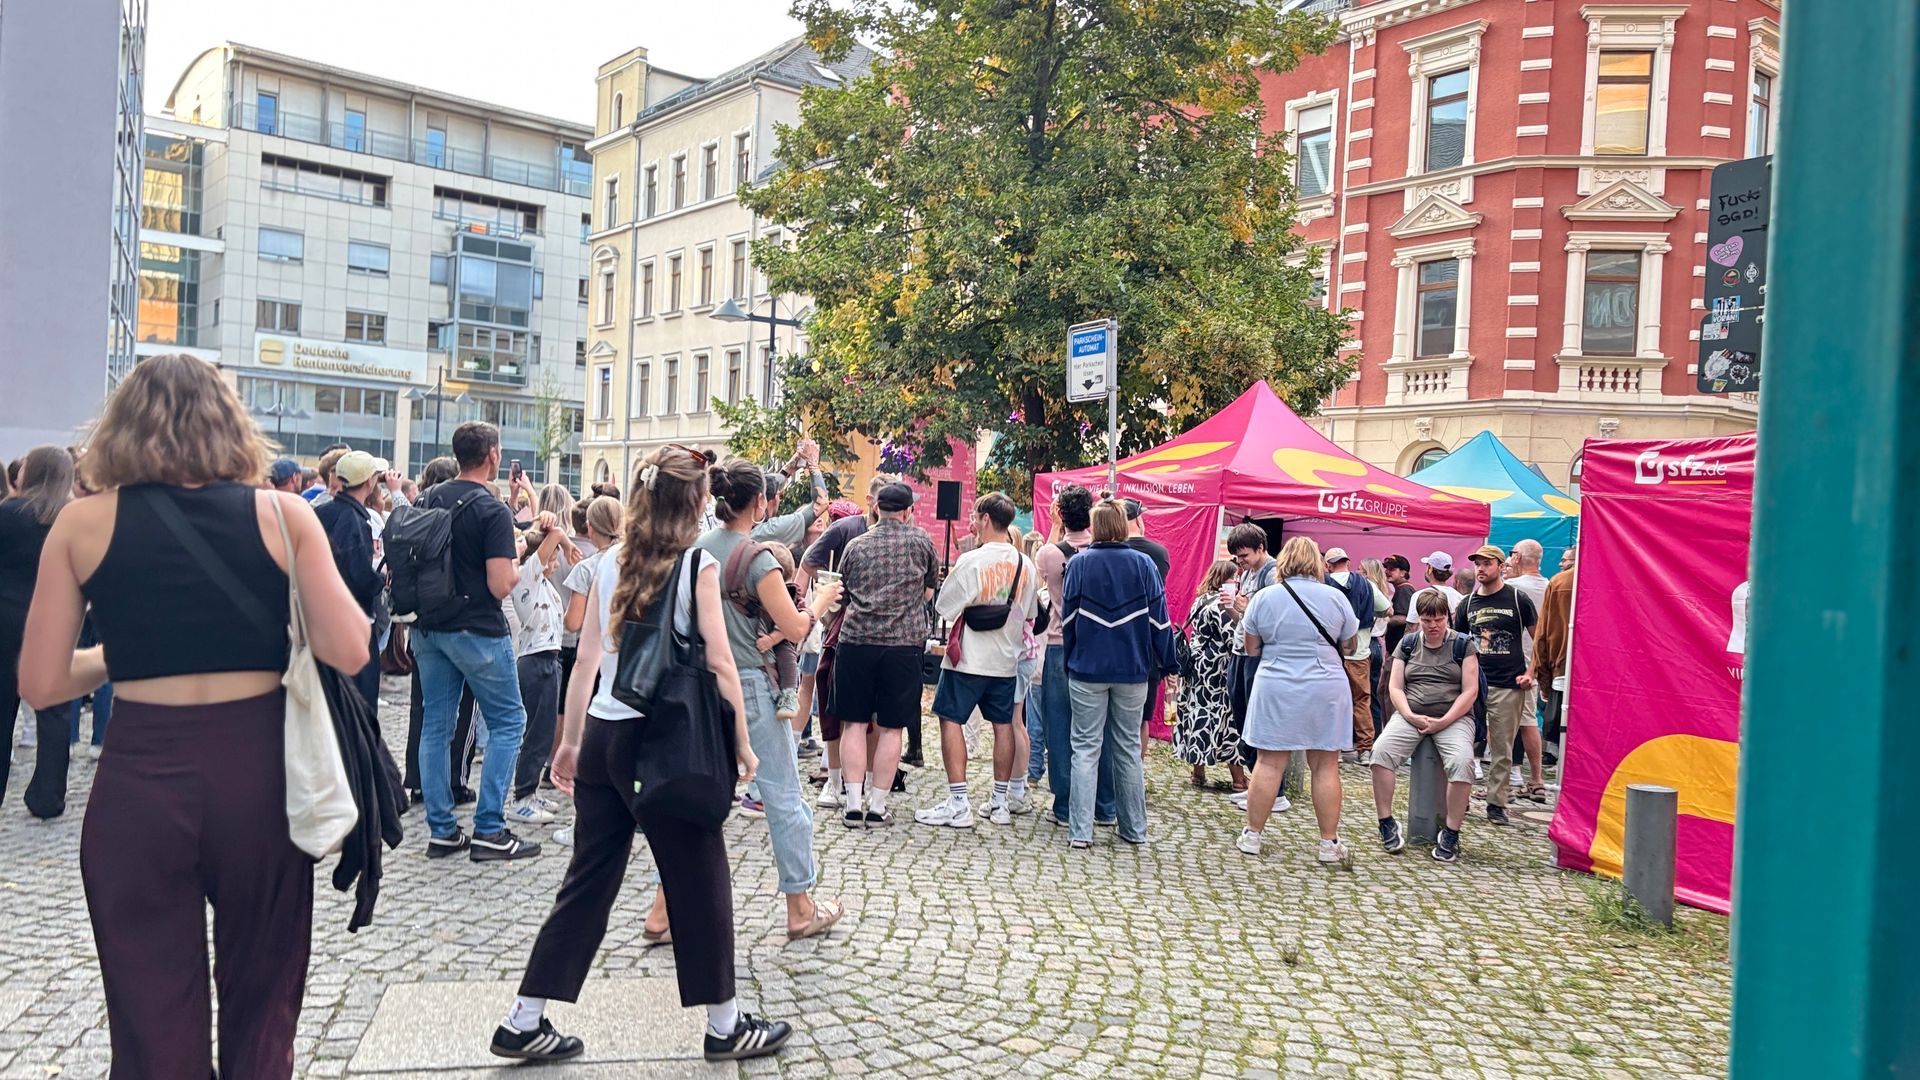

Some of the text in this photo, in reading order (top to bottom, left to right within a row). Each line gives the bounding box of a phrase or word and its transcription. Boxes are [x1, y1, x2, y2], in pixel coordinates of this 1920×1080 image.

[1078, 343, 1100, 353] AUTOMAT
[1667, 454, 1728, 477] sfz.de
[1168, 483, 1196, 494] LEBEN.
